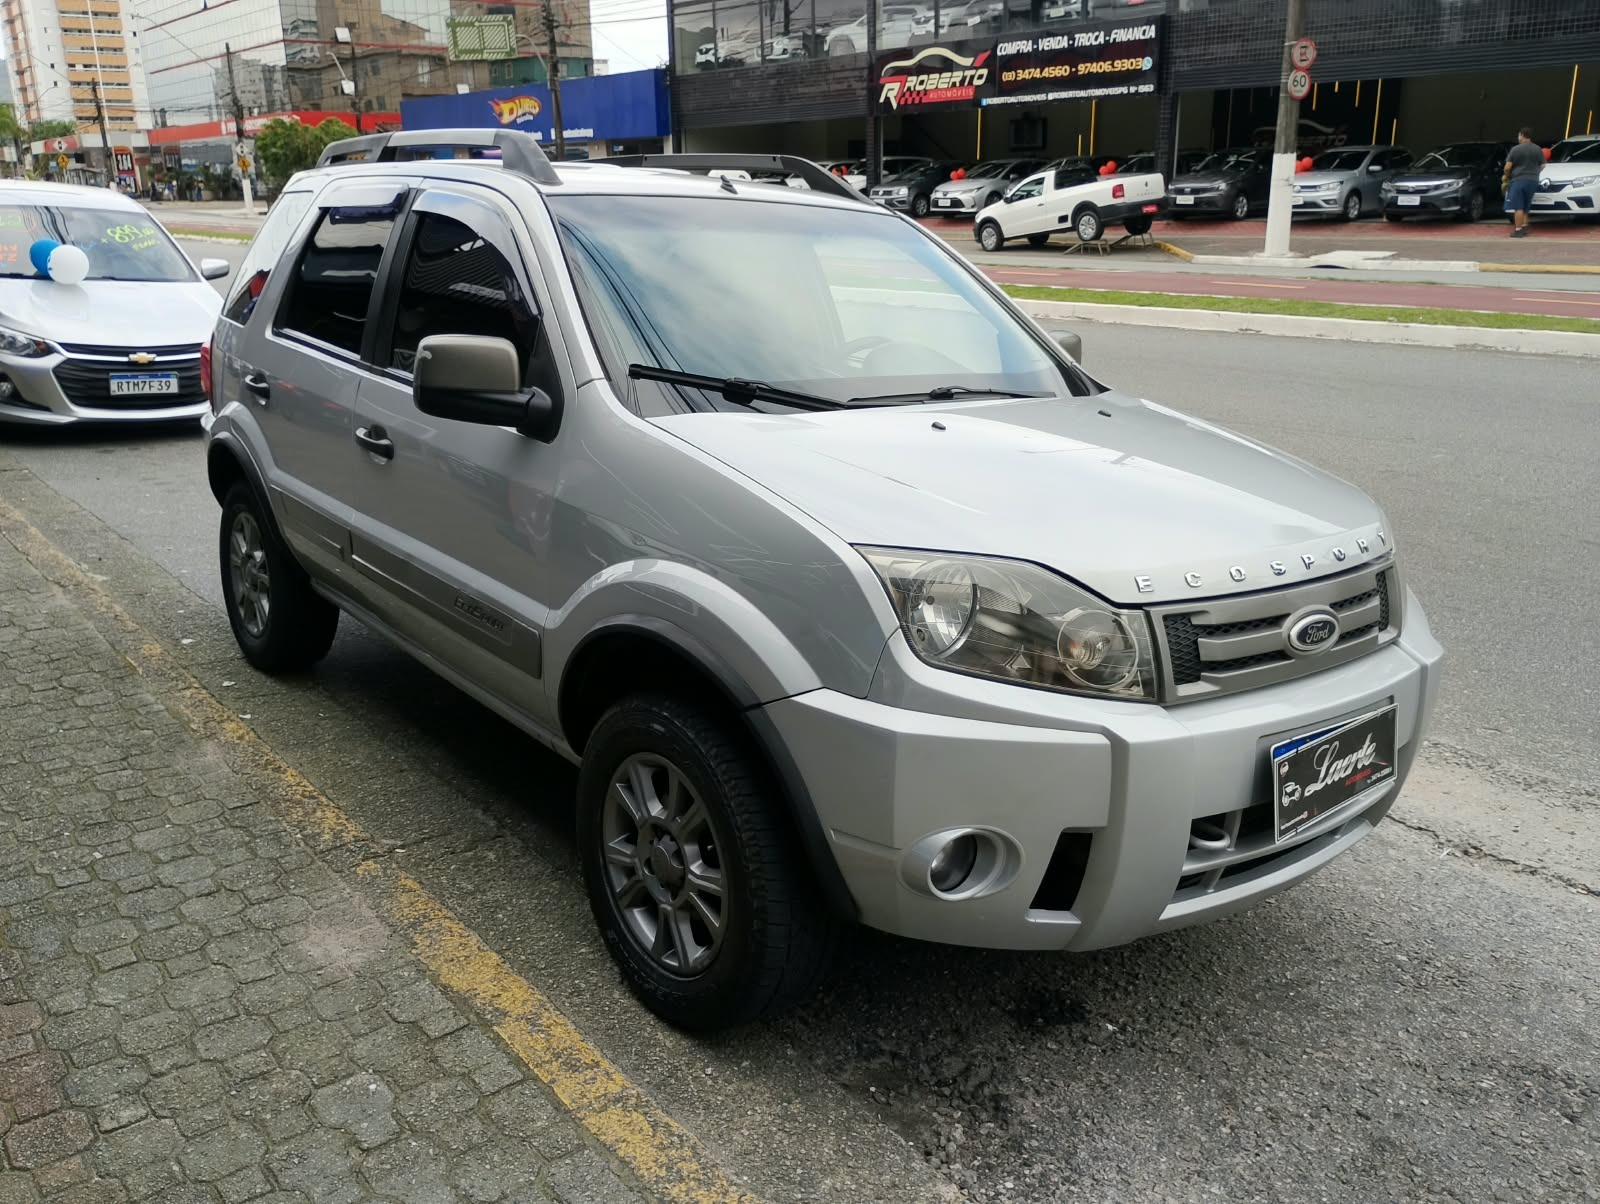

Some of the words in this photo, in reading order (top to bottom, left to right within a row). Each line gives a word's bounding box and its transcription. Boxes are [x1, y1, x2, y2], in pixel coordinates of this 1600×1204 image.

[997, 40, 1032, 56] COMPRA
[1039, 36, 1069, 50] VENDA
[1074, 31, 1104, 48] TROCA
[1110, 24, 1156, 43] FINANCIA
[904, 68, 989, 92] ROBERTO
[1016, 65, 1070, 81] 3474.4560
[1077, 57, 1143, 75] 97406.9303
[1292, 75, 1307, 88] 60
[117, 380, 171, 393] RTM7F39
[1134, 531, 1386, 593] ECOSPORT
[1305, 623, 1331, 644] Ford
